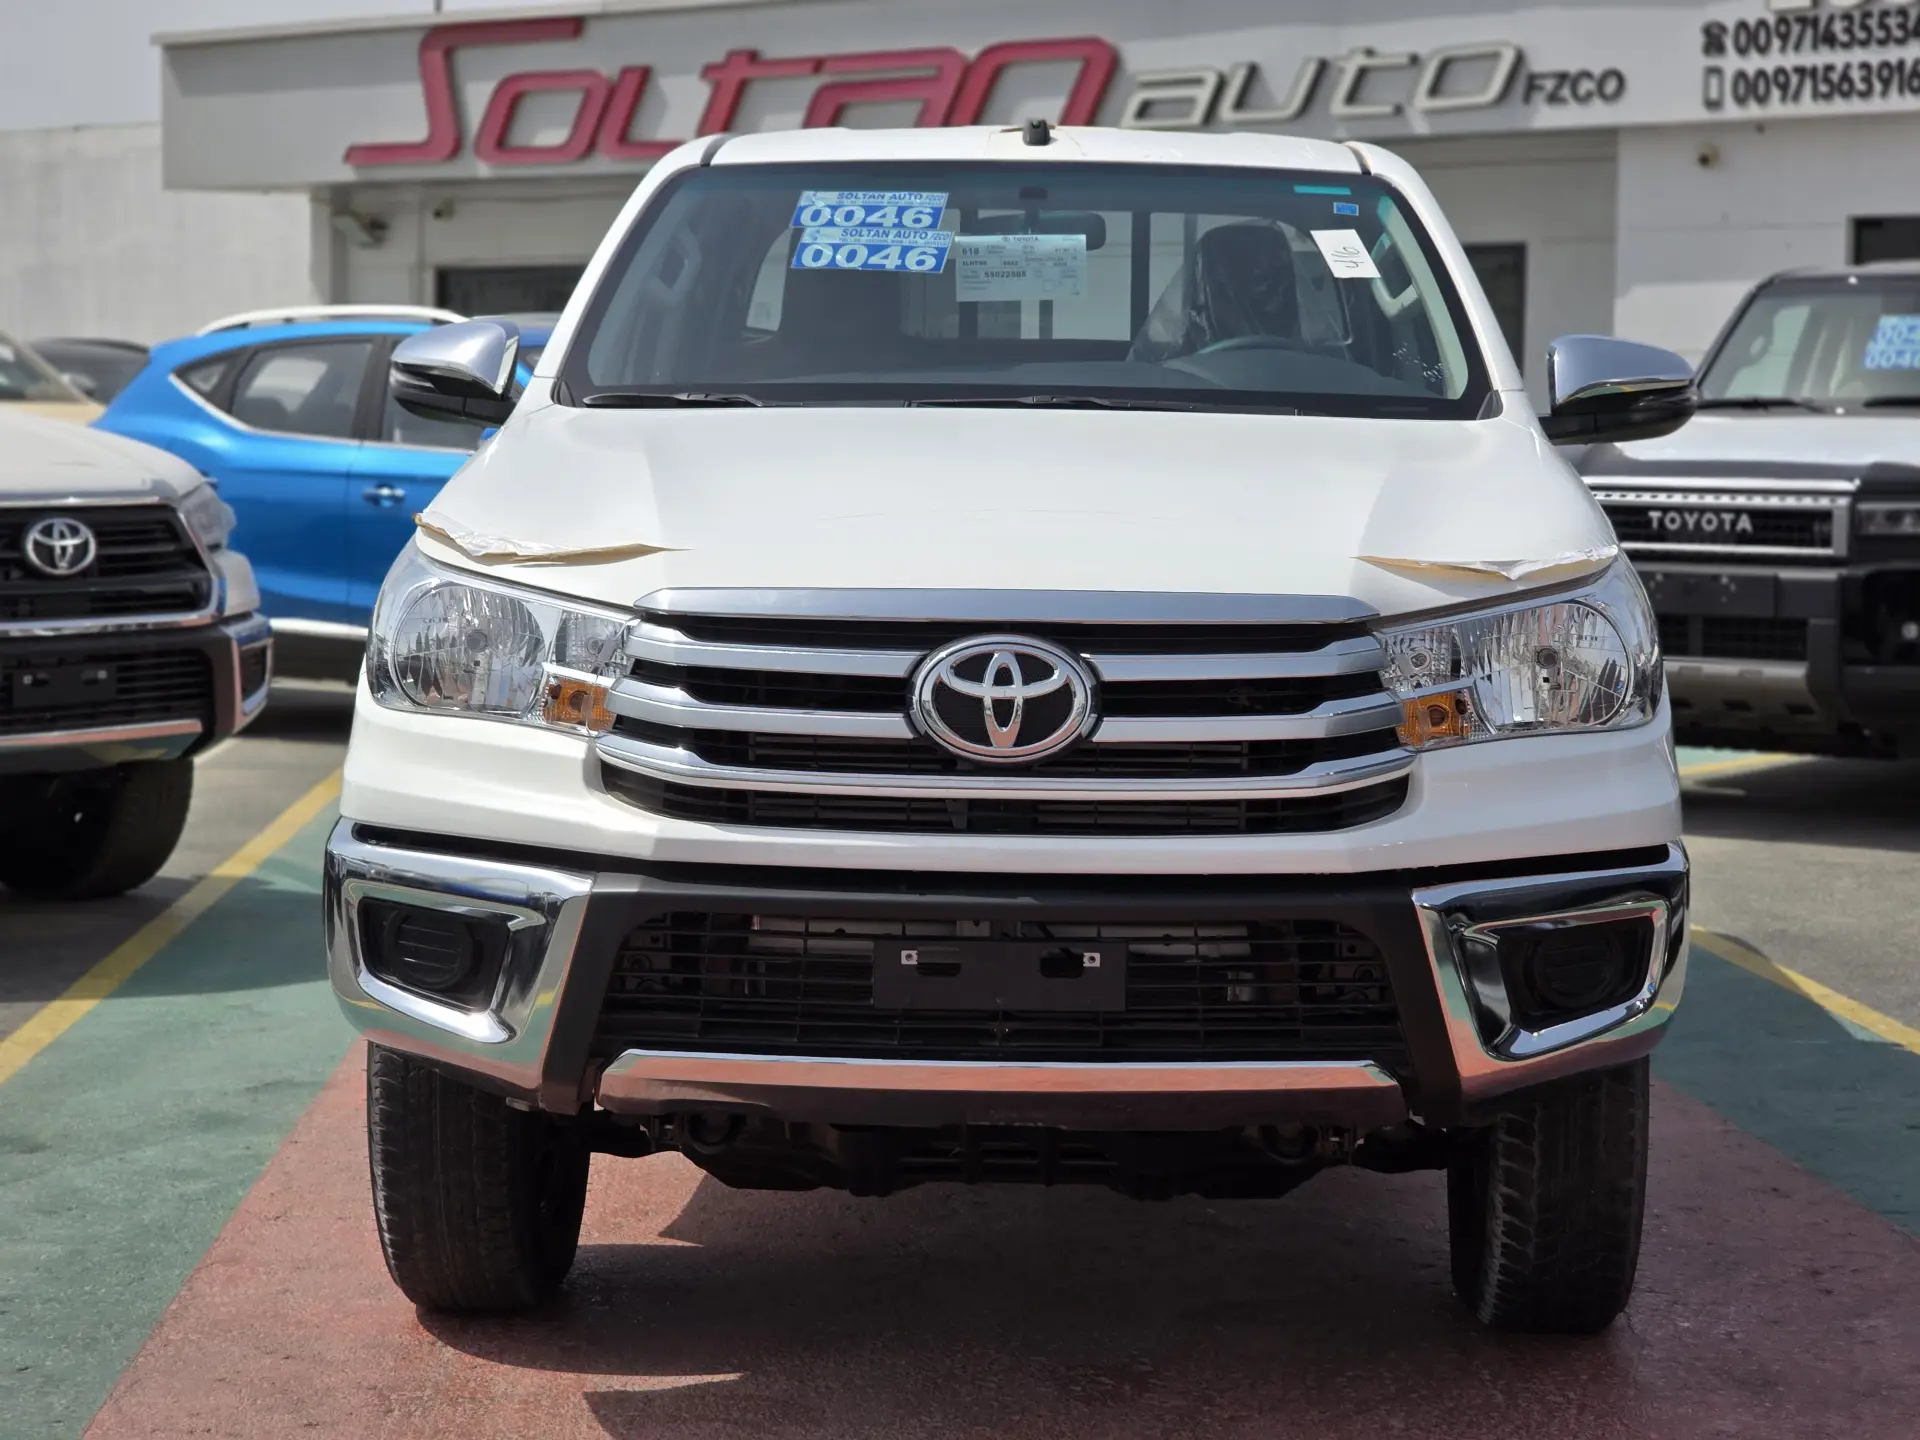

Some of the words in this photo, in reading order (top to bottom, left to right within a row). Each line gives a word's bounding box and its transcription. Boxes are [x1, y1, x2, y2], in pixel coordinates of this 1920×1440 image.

[1524, 68, 1626, 106] FZCO
[837, 192, 886, 200] SOLTAN
[889, 192, 923, 201] AUTO
[800, 205, 935, 229] 0046
[841, 228, 890, 238] SOLTAN
[893, 229, 928, 240] AUTO
[801, 243, 938, 271] 0046
[1648, 510, 1753, 534] TOYOTA
